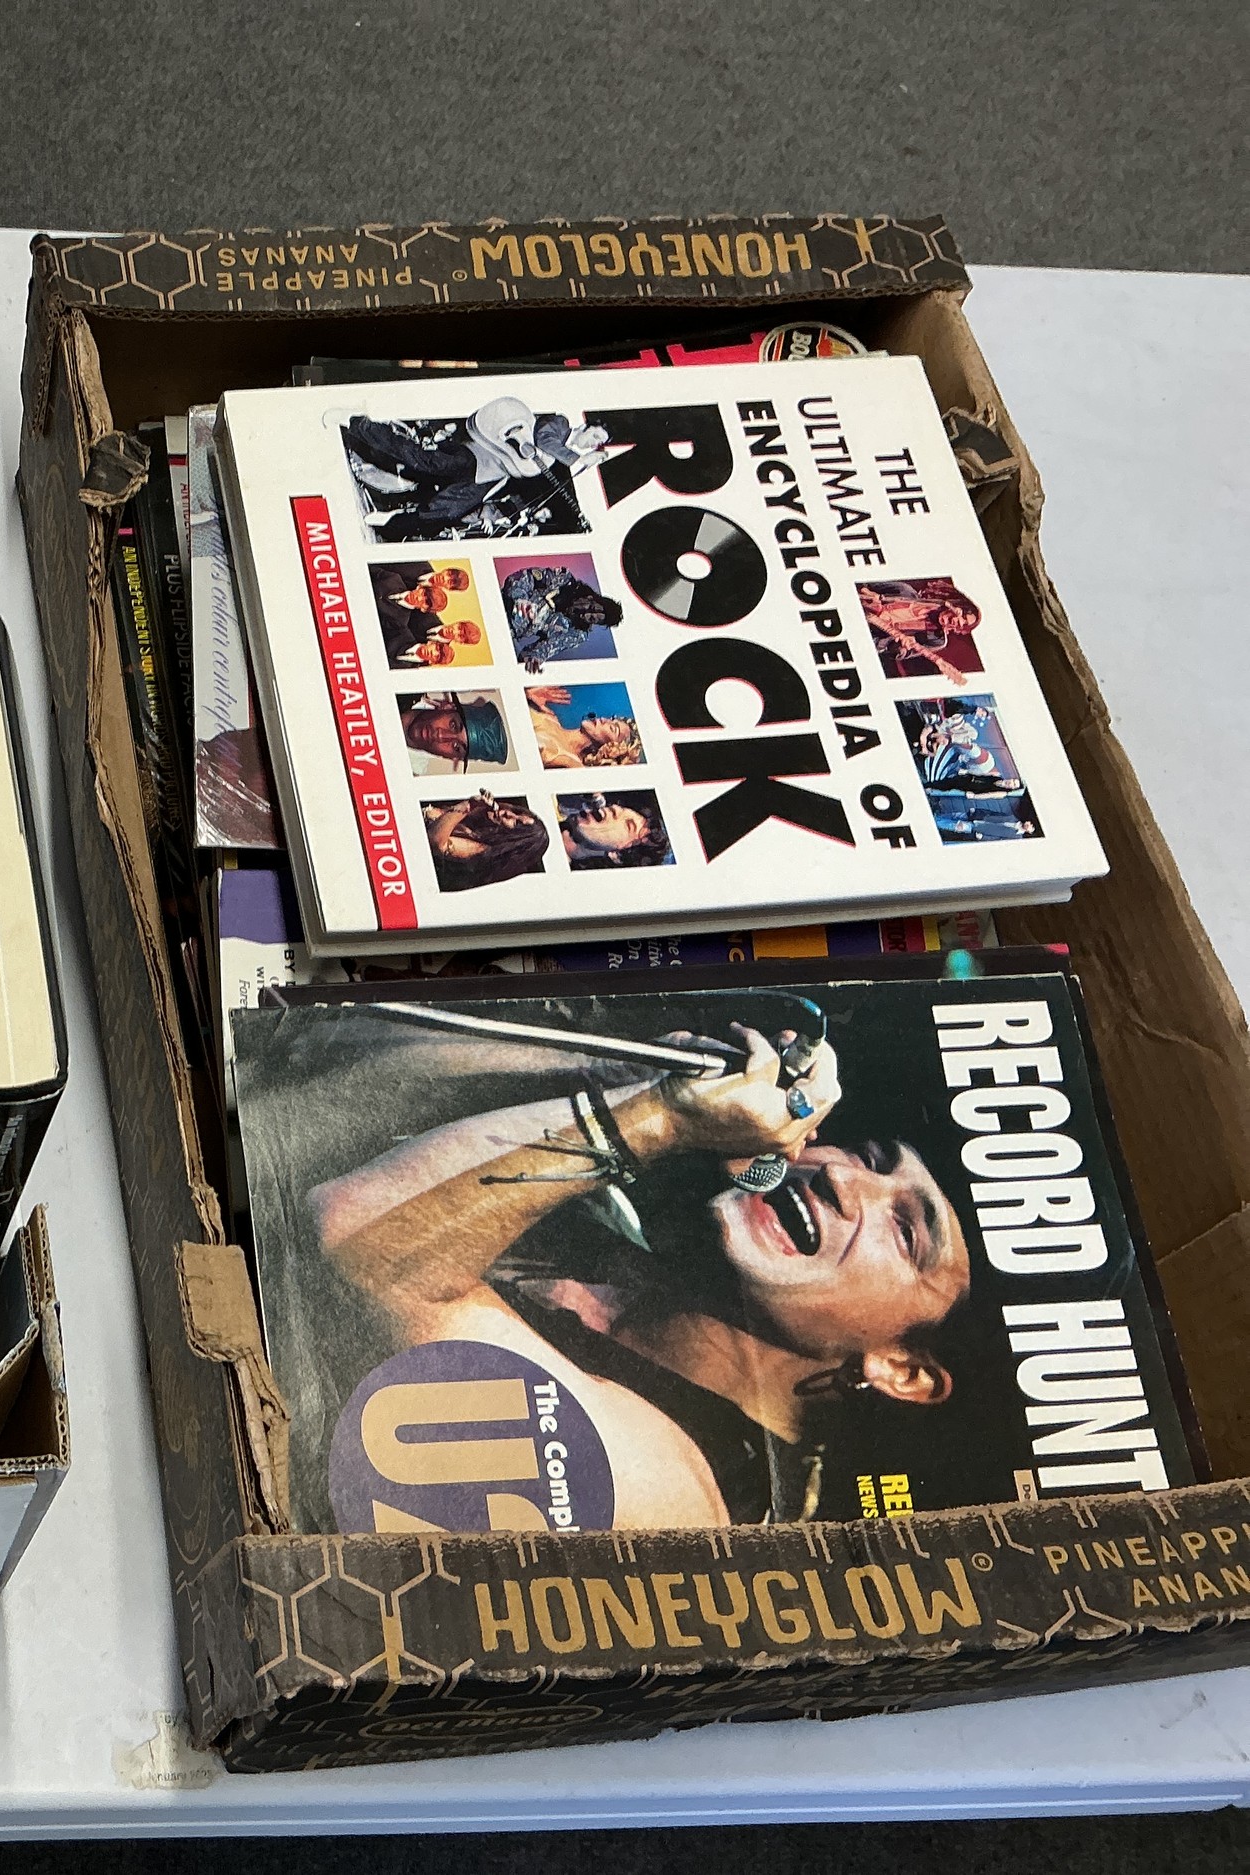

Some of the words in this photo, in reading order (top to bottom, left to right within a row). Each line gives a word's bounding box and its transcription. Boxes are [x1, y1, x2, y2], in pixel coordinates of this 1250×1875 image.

[217, 244, 359, 264] ANANAS
[217, 266, 411, 290] PINEAPPLE
[471, 232, 813, 283] HONEYGLOW
[796, 397, 886, 569] ULTIMATE
[875, 447, 930, 516] THE
[304, 519, 355, 642] MICHAEL
[736, 401, 883, 762] ENCYCLOPEDIA
[859, 783, 918, 851] OF
[581, 403, 856, 864] ROCK
[328, 649, 378, 776] HEATLEY,
[360, 790, 406, 899] EDITOR
[285, 950, 295, 973] BY
[931, 1001, 1109, 1274] RECORD
[1002, 1299, 1170, 1494] HUNT
[857, 1475, 878, 1517] NEWS
[473, 1558, 981, 1653] HONEYGLOW
[383, 1718, 443, 1733] Del
